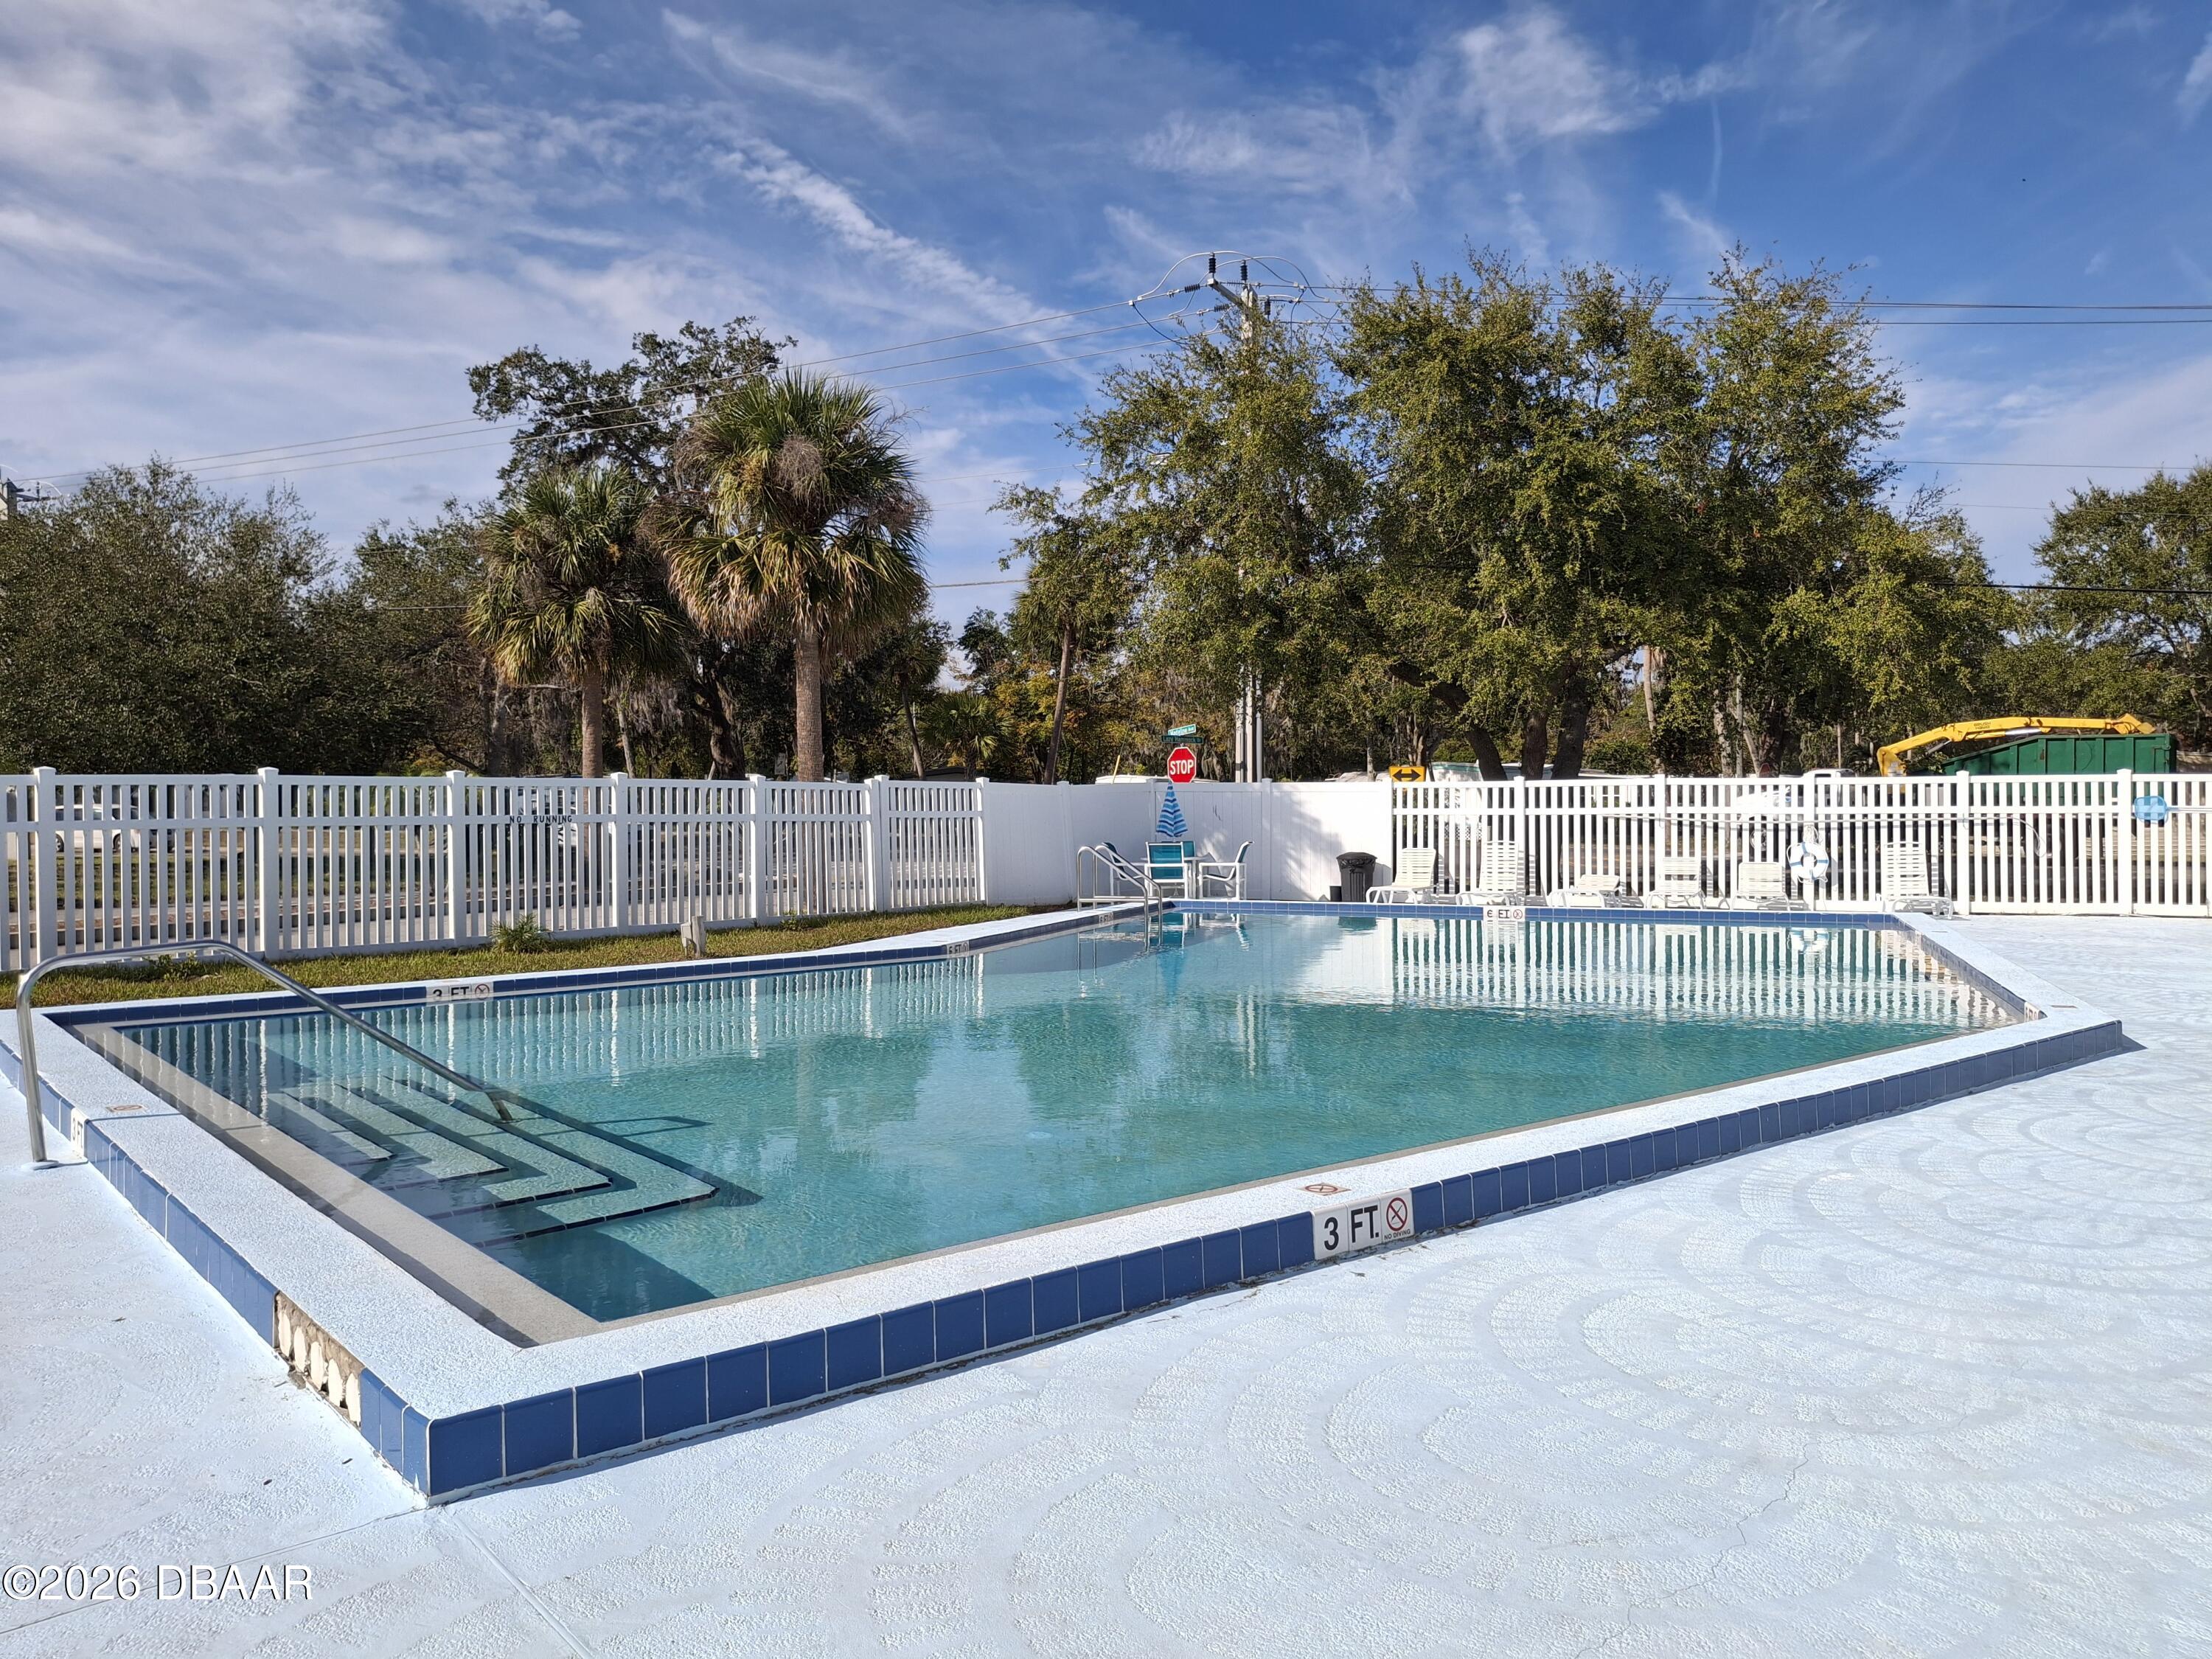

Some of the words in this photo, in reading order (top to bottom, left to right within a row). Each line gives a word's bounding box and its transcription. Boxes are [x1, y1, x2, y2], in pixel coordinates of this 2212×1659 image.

[1170, 759, 1194, 775] STOP
[509, 815, 522, 824] NO
[533, 815, 572, 824] RUNNING
[1324, 1217, 1339, 1251] 3
[1351, 1205, 1380, 1243] FT.
[1393, 1228, 1411, 1238] DIVING
